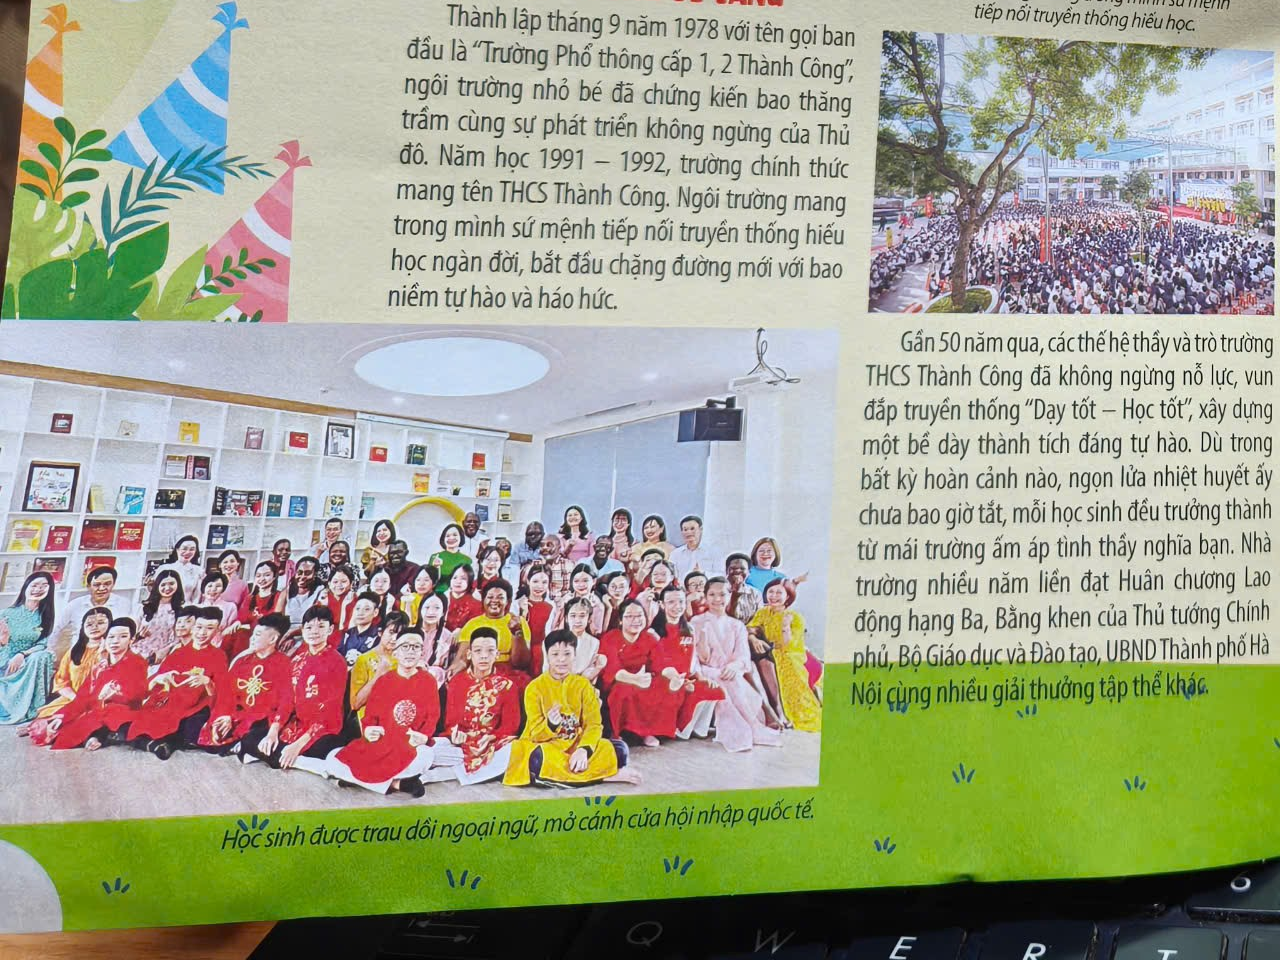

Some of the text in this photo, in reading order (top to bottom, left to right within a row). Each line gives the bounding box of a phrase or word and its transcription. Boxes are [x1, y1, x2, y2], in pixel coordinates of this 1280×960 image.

[446, 4, 855, 50] Thành lập tháng 9 năm 1978 với tên gọi ban
[974, 2, 1195, 34] tiếp nối truyền thống hiếu học.
[264, 825, 305, 848] sinh
[309, 824, 360, 845] được
[363, 825, 402, 843] trau
[405, 817, 438, 841] dồi
[439, 816, 496, 843] ngoại
[498, 814, 539, 840] ngữ,
[543, 811, 577, 833] mở
[578, 809, 624, 831] cánh
[627, 807, 661, 829] cửa
[664, 806, 695, 830] hội
[697, 803, 744, 828] nhập
[747, 798, 792, 826] quốc
[795, 797, 814, 819] tế.
